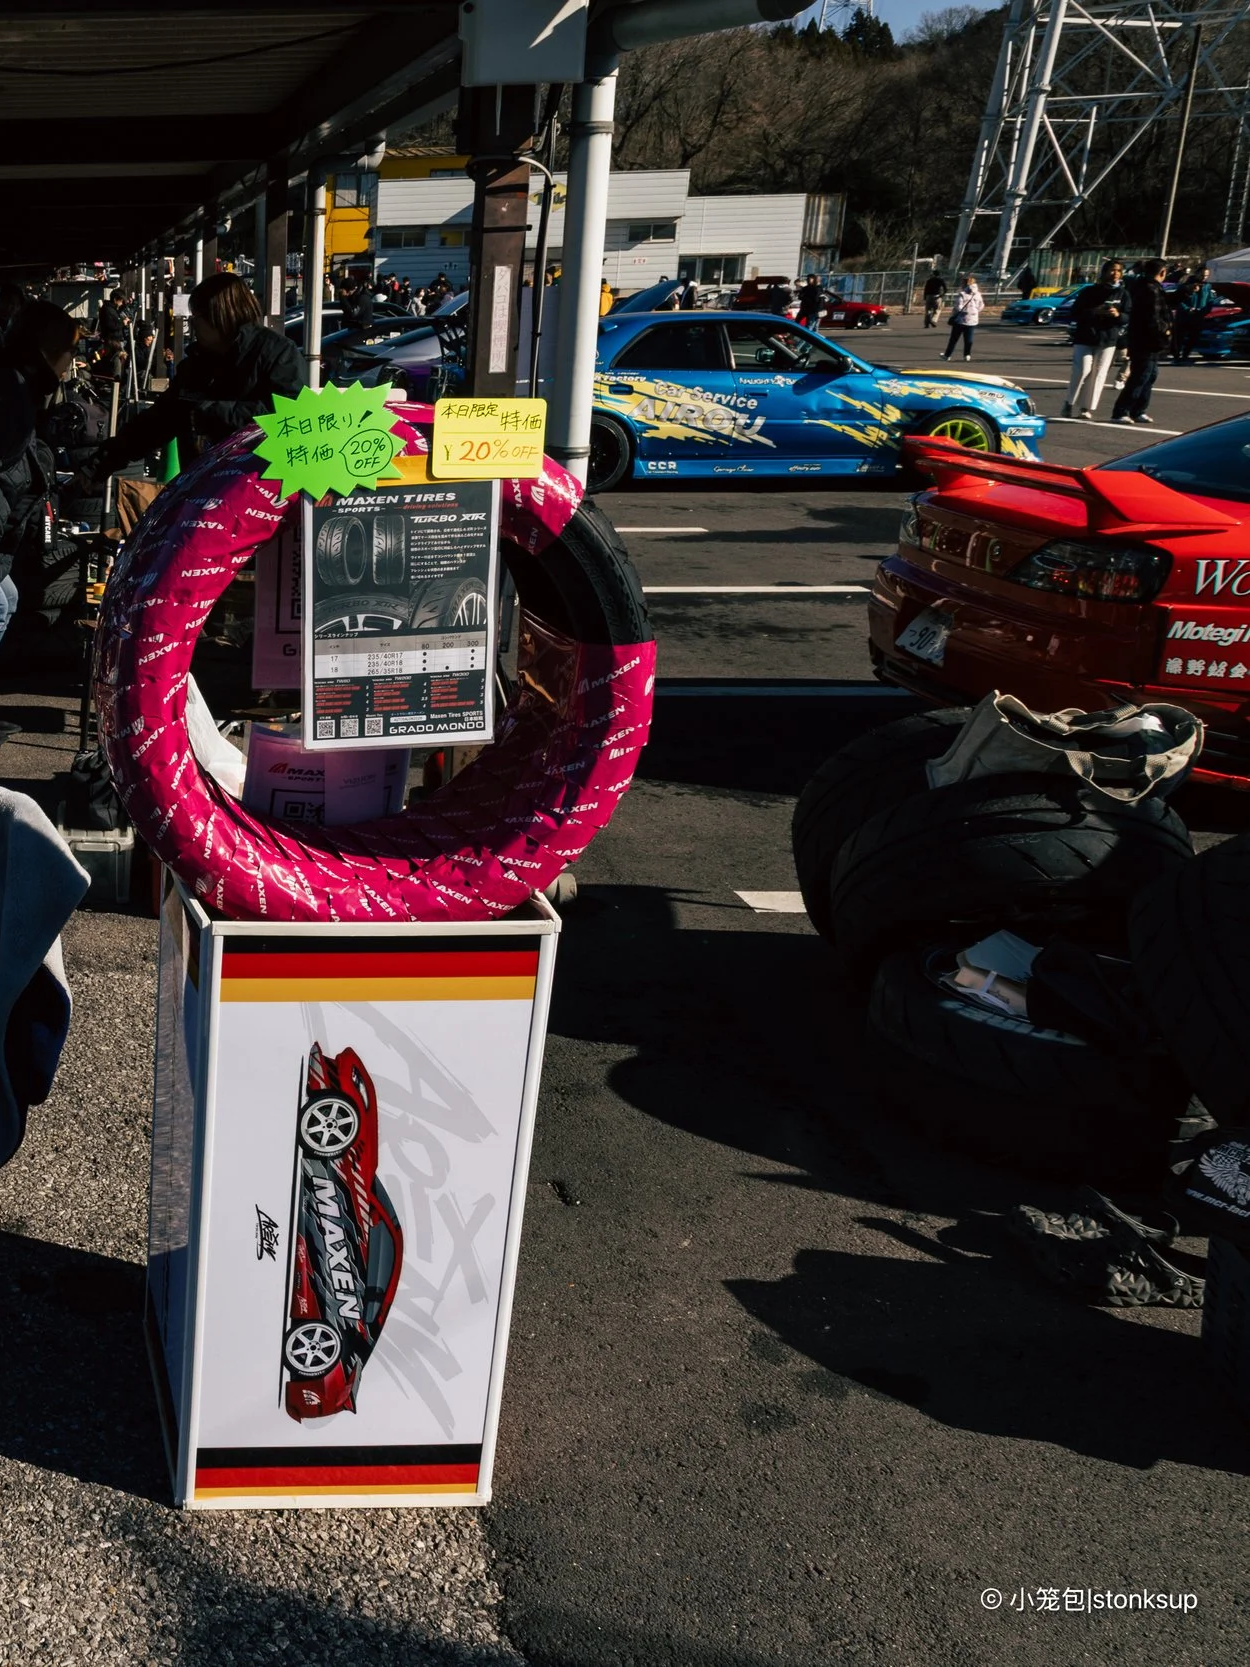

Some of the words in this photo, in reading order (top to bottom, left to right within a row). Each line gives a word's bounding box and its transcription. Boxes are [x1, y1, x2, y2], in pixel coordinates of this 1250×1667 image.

[654, 382, 685, 397] Car
[690, 386, 759, 410] Service
[441, 402, 499, 419] 本日限定
[499, 412, 543, 432] 特価
[627, 397, 767, 437] AIROU
[286, 443, 334, 467] 特価
[350, 438, 387, 457] 20%
[459, 440, 509, 462] 20%
[512, 445, 540, 458] OFF
[354, 459, 381, 469] OFF
[648, 461, 677, 470] CCR
[336, 495, 399, 506] MAXEN
[403, 493, 457, 503] TIRES
[410, 515, 457, 523] TURBO
[184, 608, 212, 631] XEN
[1167, 621, 1248, 647] Motegi
[591, 656, 641, 690] MAXEN
[163, 672, 188, 705] AXEN
[389, 724, 434, 734] GRADO
[436, 721, 484, 731] MONDO
[287, 767, 325, 777] MAX
[449, 854, 484, 867] AXEN
[311, 1175, 362, 1320] MAXEN
